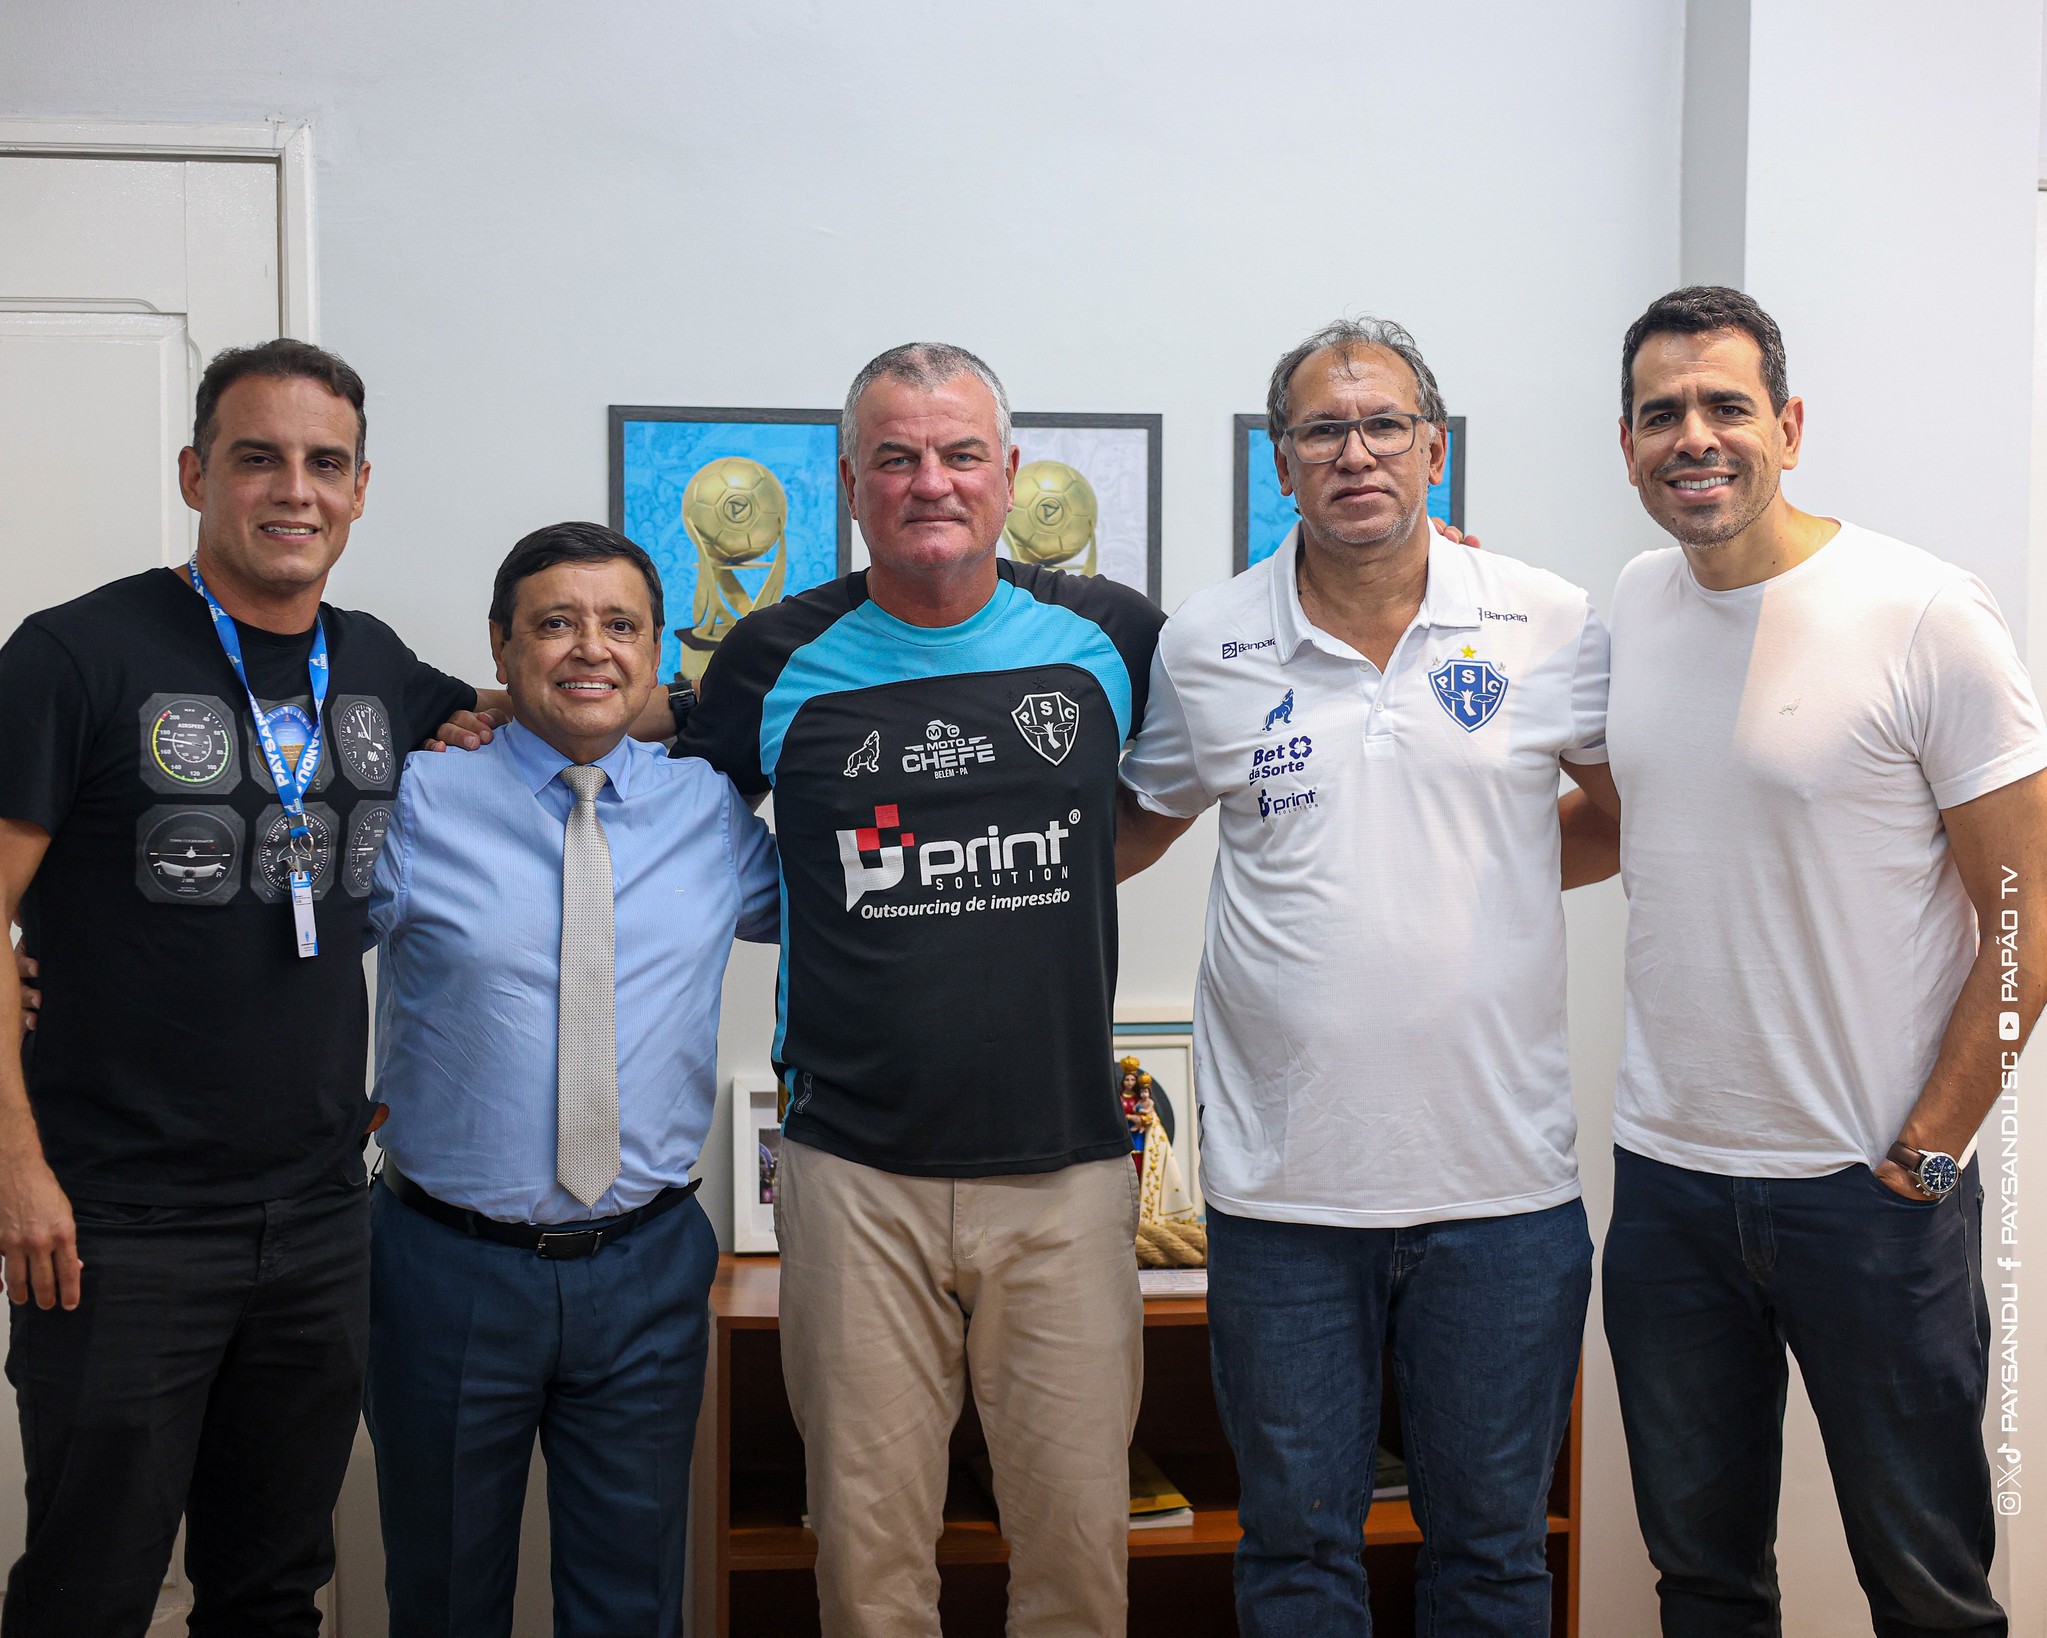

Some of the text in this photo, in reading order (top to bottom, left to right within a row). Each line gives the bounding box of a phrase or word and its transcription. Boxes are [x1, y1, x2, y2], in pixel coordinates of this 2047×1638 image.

[177, 722, 206, 730] AIRSPEED
[926, 738, 966, 751] MOTO
[902, 743, 996, 773] CHEFE
[1252, 744, 1286, 767] Bet
[934, 768, 955, 780] BELÉM
[959, 766, 969, 776] PA
[1248, 761, 1305, 781] dá Sorte
[935, 865, 1069, 891] SOLUTION
[860, 887, 1071, 920] Outsourcing de impressão
